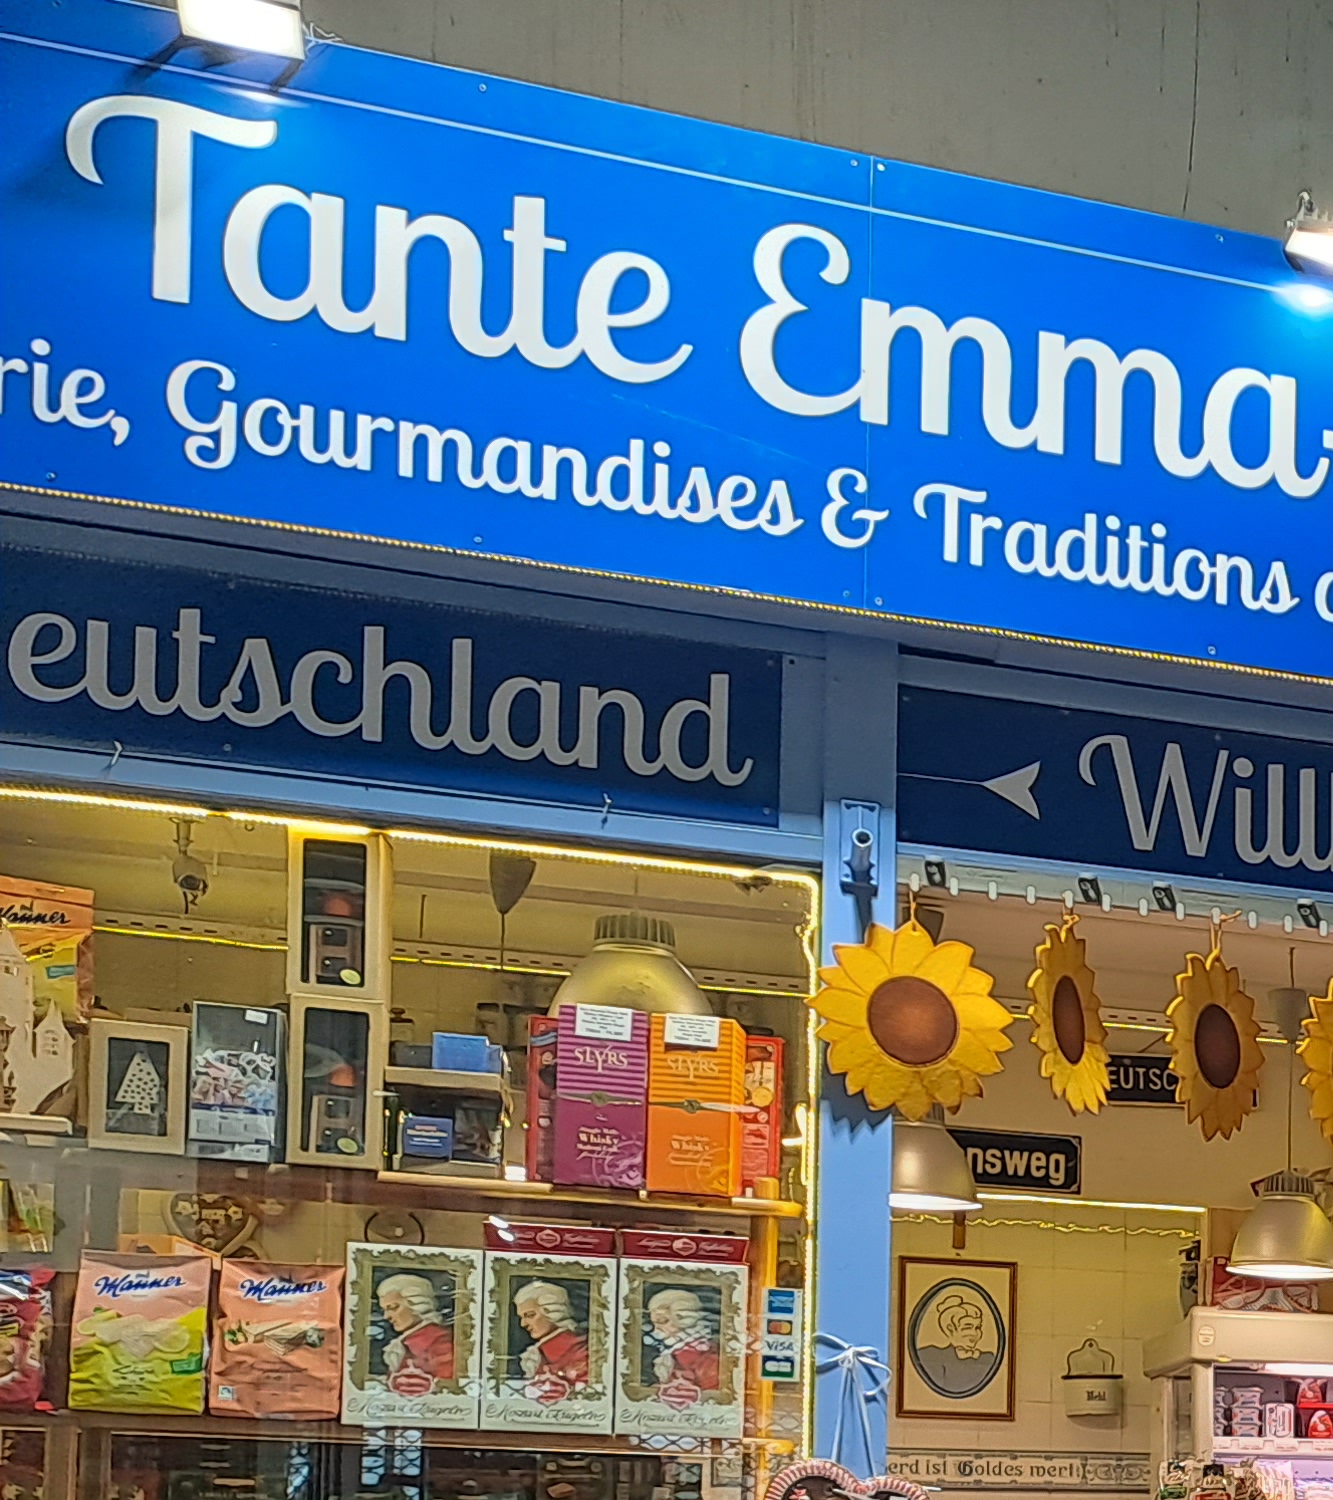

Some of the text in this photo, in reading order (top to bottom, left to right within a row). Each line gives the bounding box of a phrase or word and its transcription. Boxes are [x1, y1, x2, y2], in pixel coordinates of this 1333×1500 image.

[65, 95, 694, 384] Tante
[166, 360, 803, 537] Gourmandises
[821, 468, 889, 549] &
[913, 483, 1300, 613] Traditions
[7, 607, 754, 787] eutschland
[573, 1045, 629, 1073] SLYRS
[94, 1275, 187, 1298] Manner
[240, 1279, 327, 1302] Manner
[766, 1340, 796, 1352] VISA
